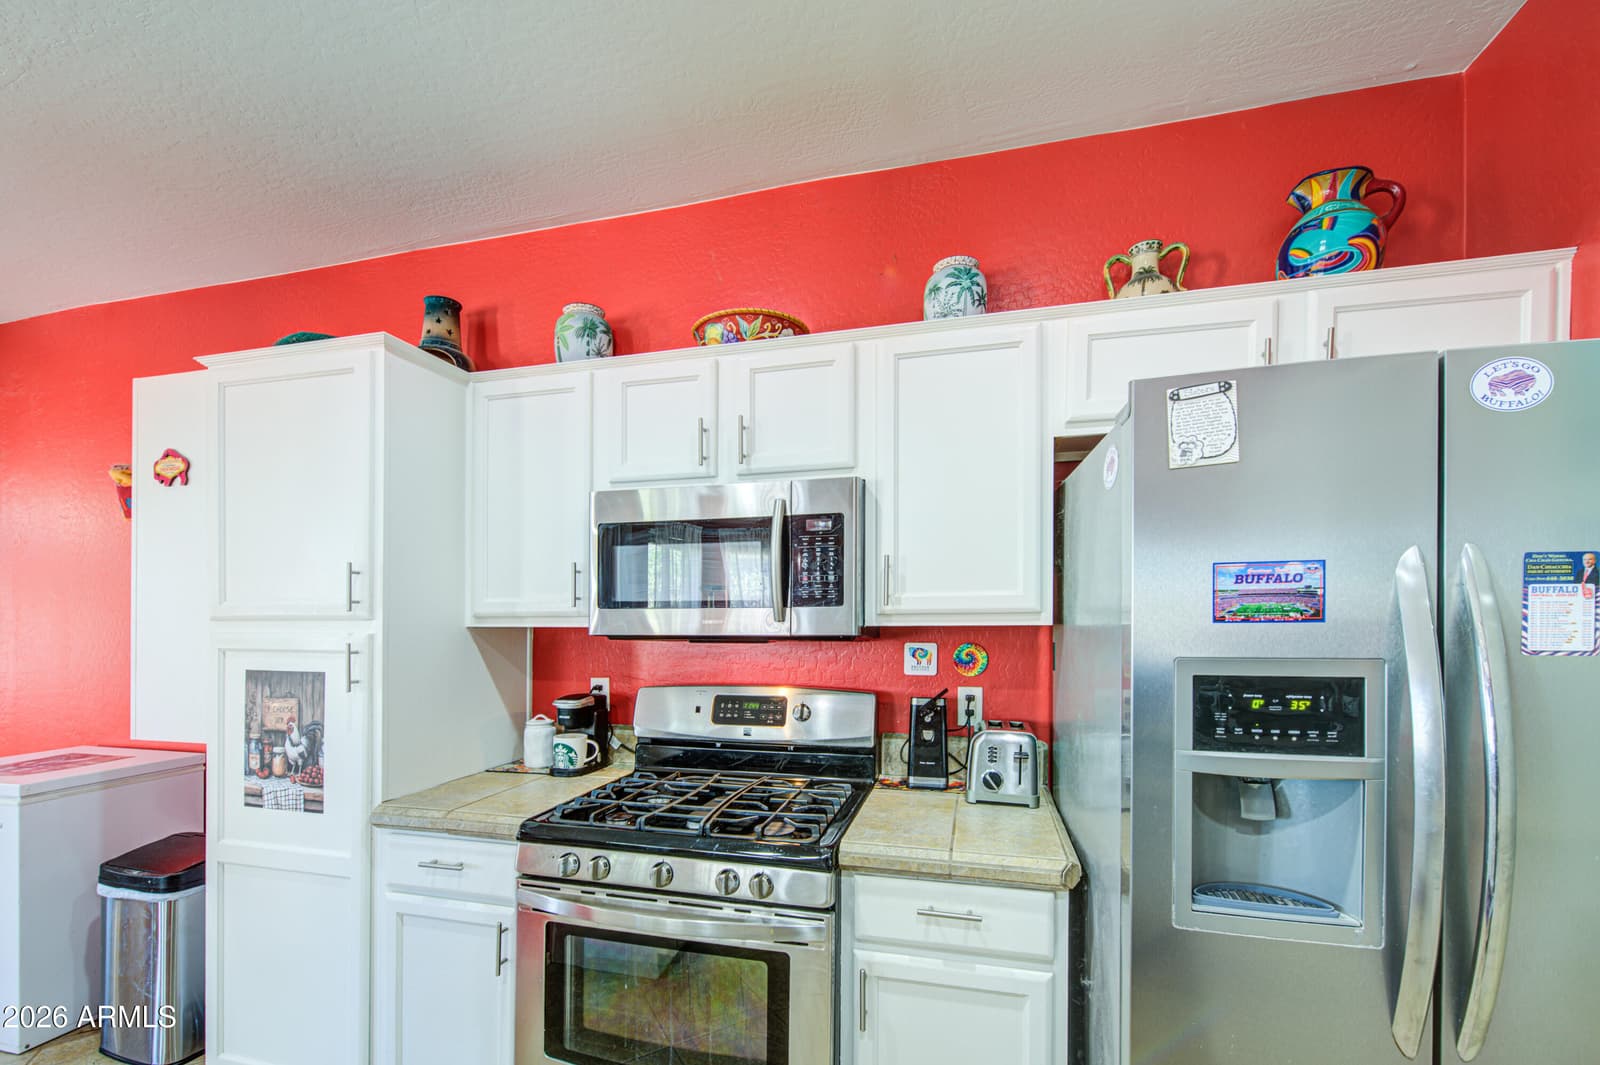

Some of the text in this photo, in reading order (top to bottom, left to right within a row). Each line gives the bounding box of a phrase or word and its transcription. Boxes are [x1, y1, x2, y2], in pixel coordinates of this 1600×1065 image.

[1484, 360, 1541, 378] LET'S GO
[1481, 389, 1544, 408] BUFFALO!
[1234, 573, 1303, 584] BUFFALO
[1531, 586, 1579, 594] BUFFALO
